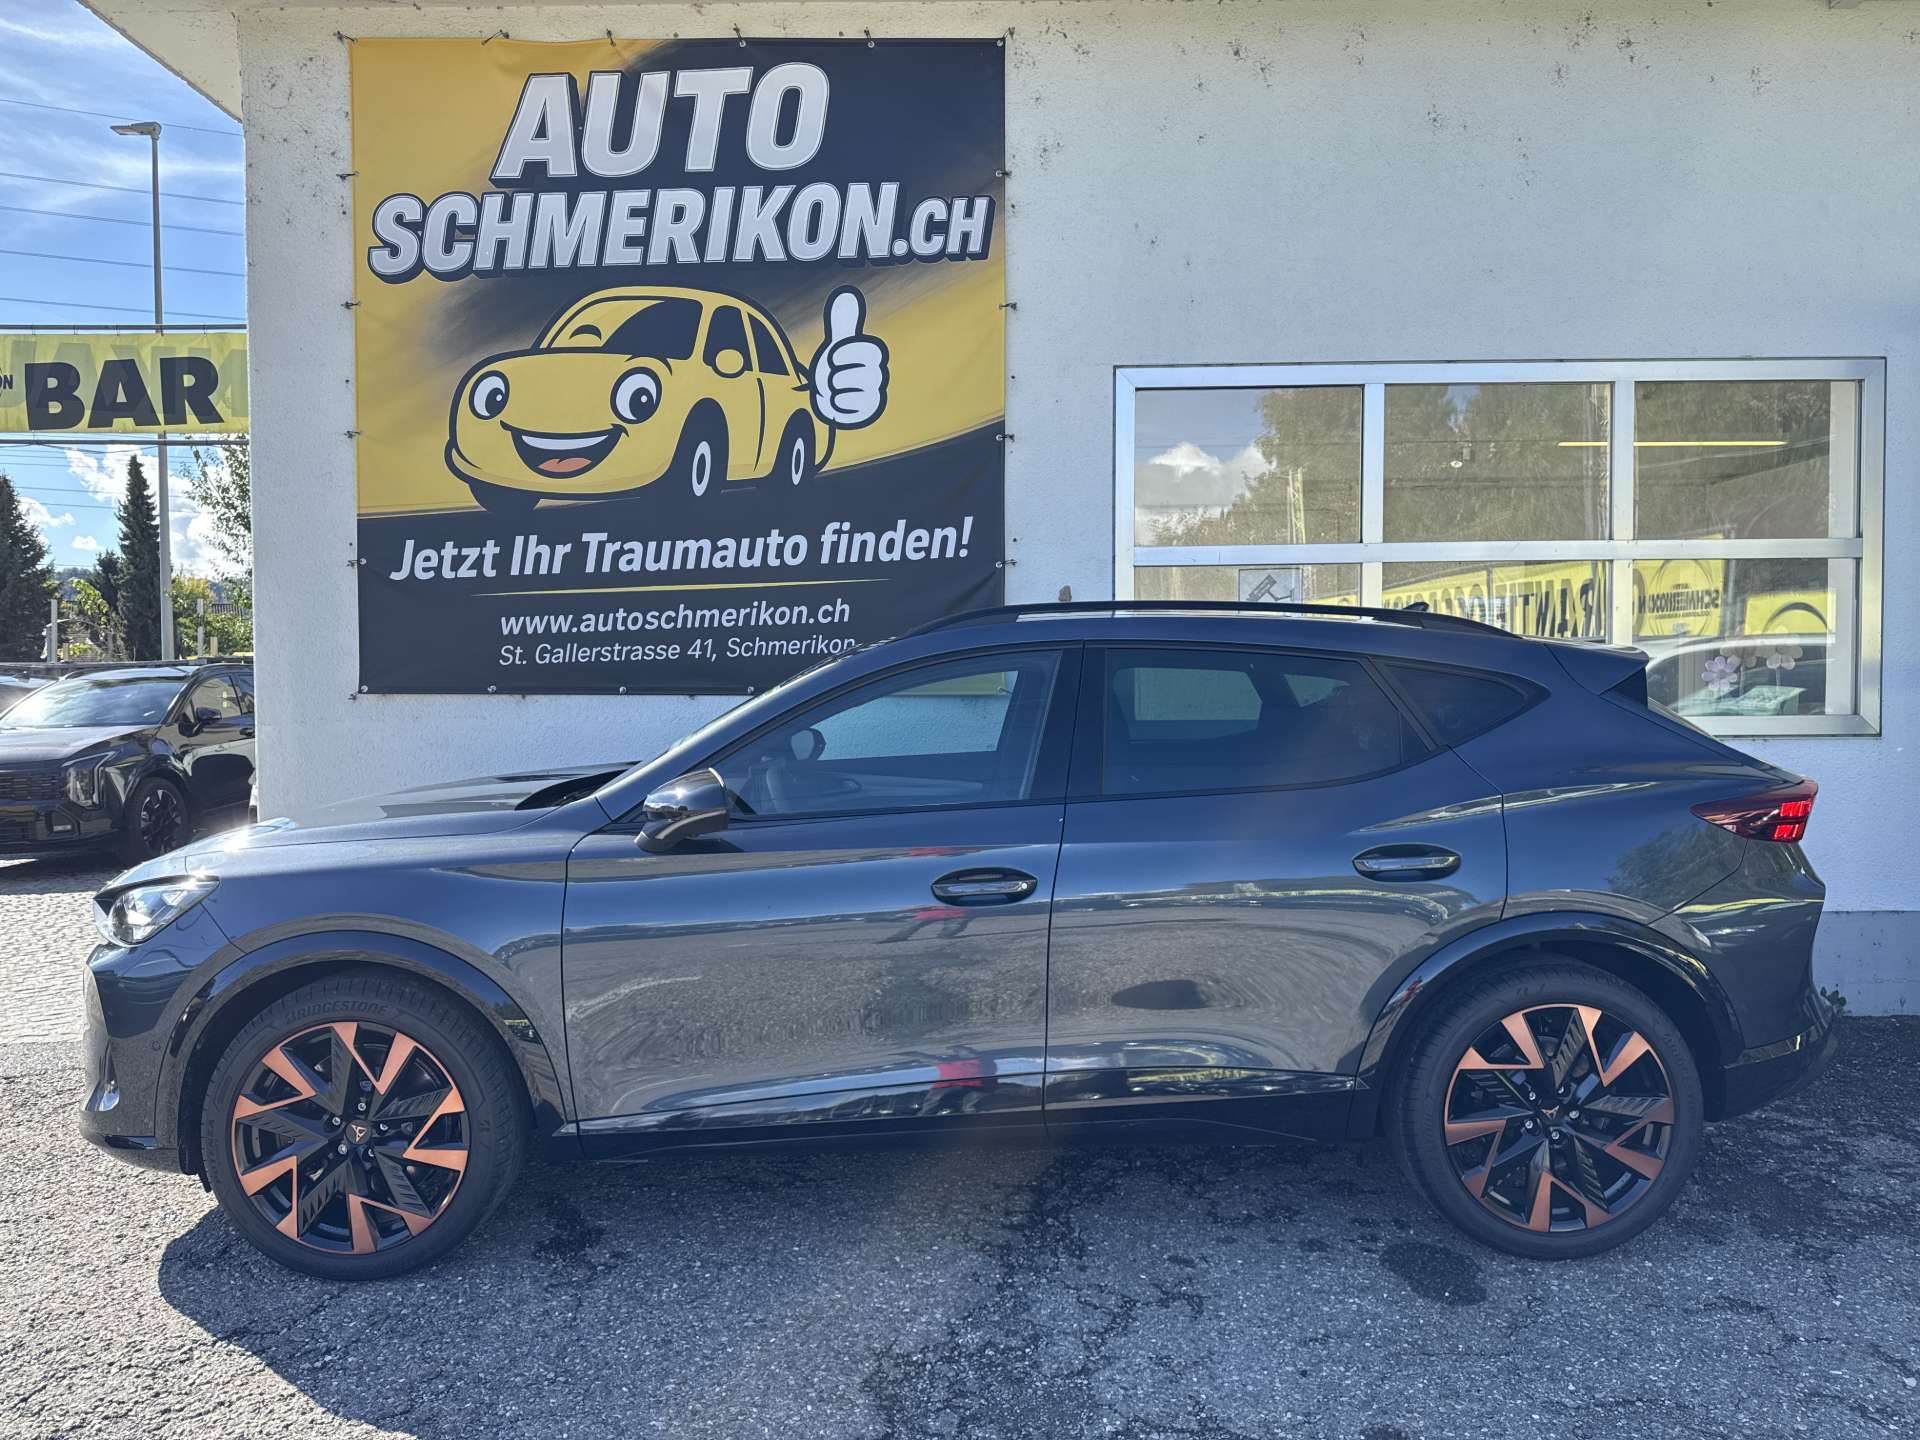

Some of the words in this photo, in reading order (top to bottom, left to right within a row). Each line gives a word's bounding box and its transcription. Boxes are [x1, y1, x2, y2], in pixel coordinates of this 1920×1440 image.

[492, 61, 830, 180] AUTO
[367, 181, 992, 277] SCHMERIKON.CH
[24, 356, 225, 431] BAR
[389, 538, 501, 581] Jetzt
[510, 533, 572, 577] Ihr
[580, 526, 808, 574] Traumauto
[819, 515, 975, 566] finden!
[498, 643, 528, 666] St.
[534, 638, 681, 665] Gallerstrasse
[686, 636, 718, 663] 41,
[725, 633, 856, 659] Schmerikon
[499, 597, 852, 636] www.autoschmerikon.ch
